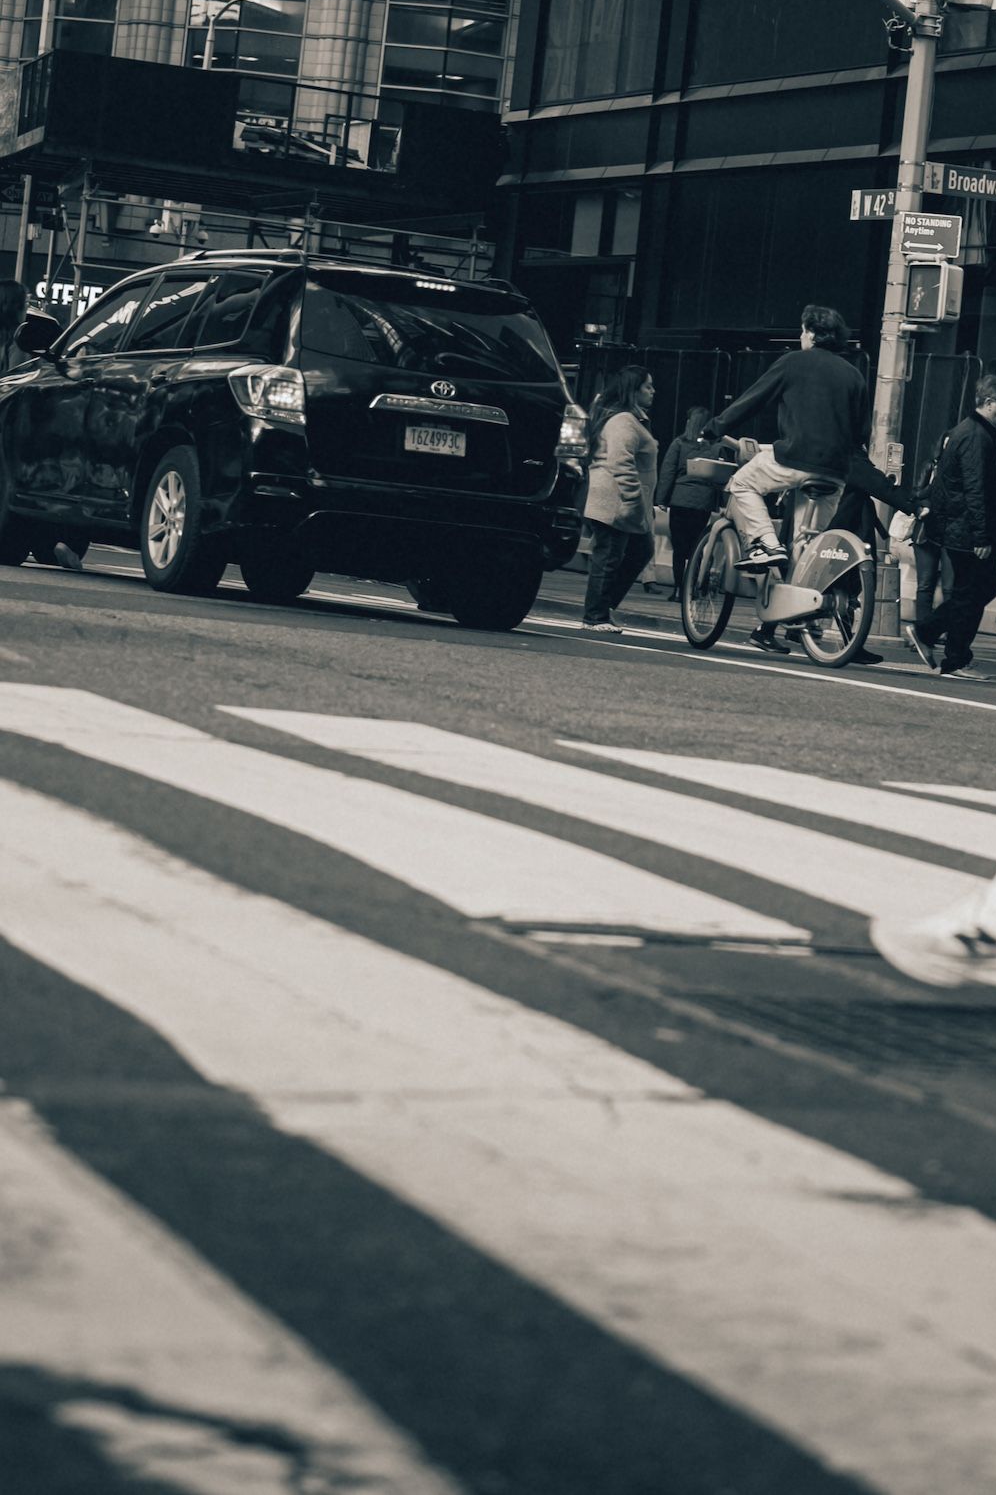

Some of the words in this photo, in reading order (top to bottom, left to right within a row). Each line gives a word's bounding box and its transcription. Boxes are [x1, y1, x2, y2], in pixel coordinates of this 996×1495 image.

[864, 194, 873, 216] W
[873, 194, 886, 216] 42
[905, 216, 916, 226] NO
[917, 217, 952, 228] STANDING
[904, 226, 935, 236] Anytime
